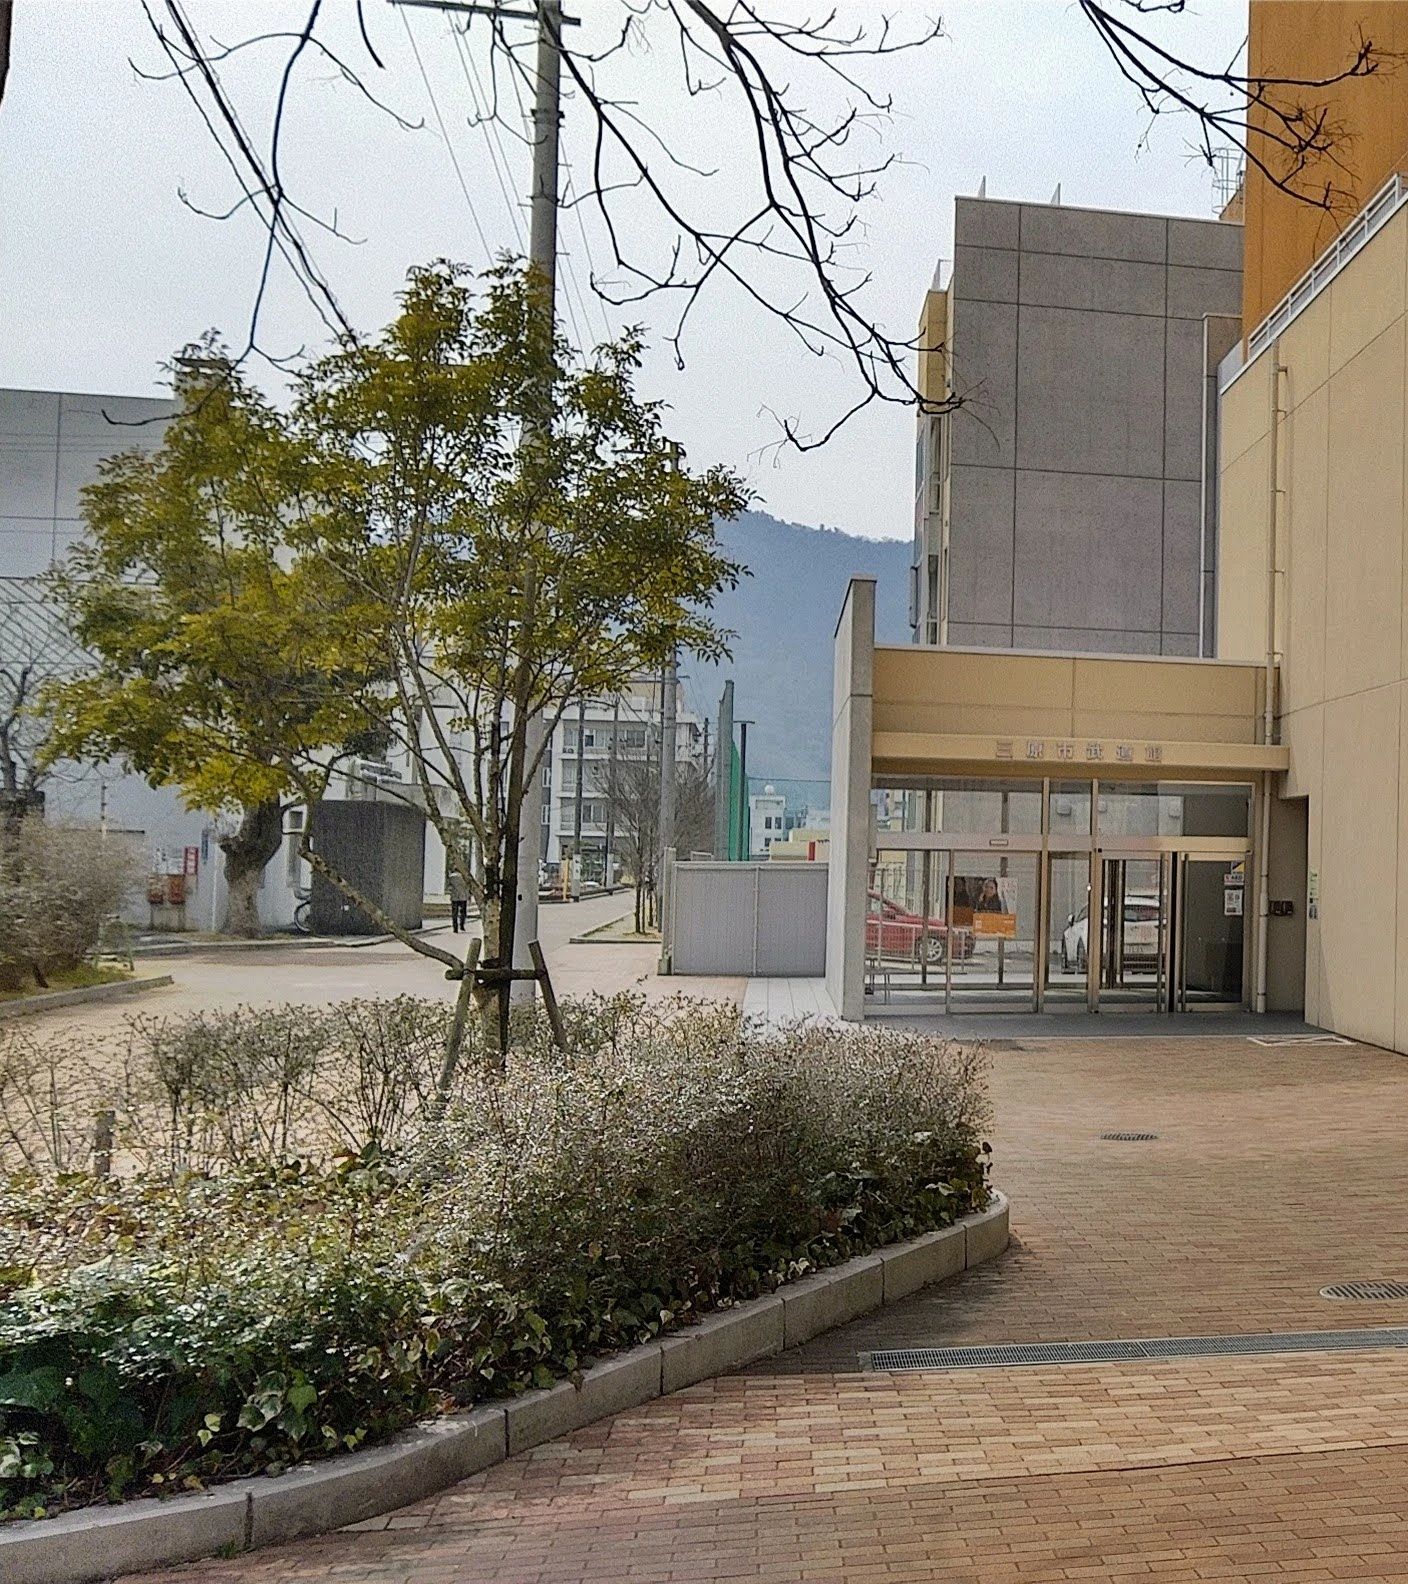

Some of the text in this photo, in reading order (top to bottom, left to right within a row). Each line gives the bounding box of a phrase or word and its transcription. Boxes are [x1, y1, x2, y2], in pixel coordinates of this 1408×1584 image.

[995, 741, 1163, 763] 三原市武道館
